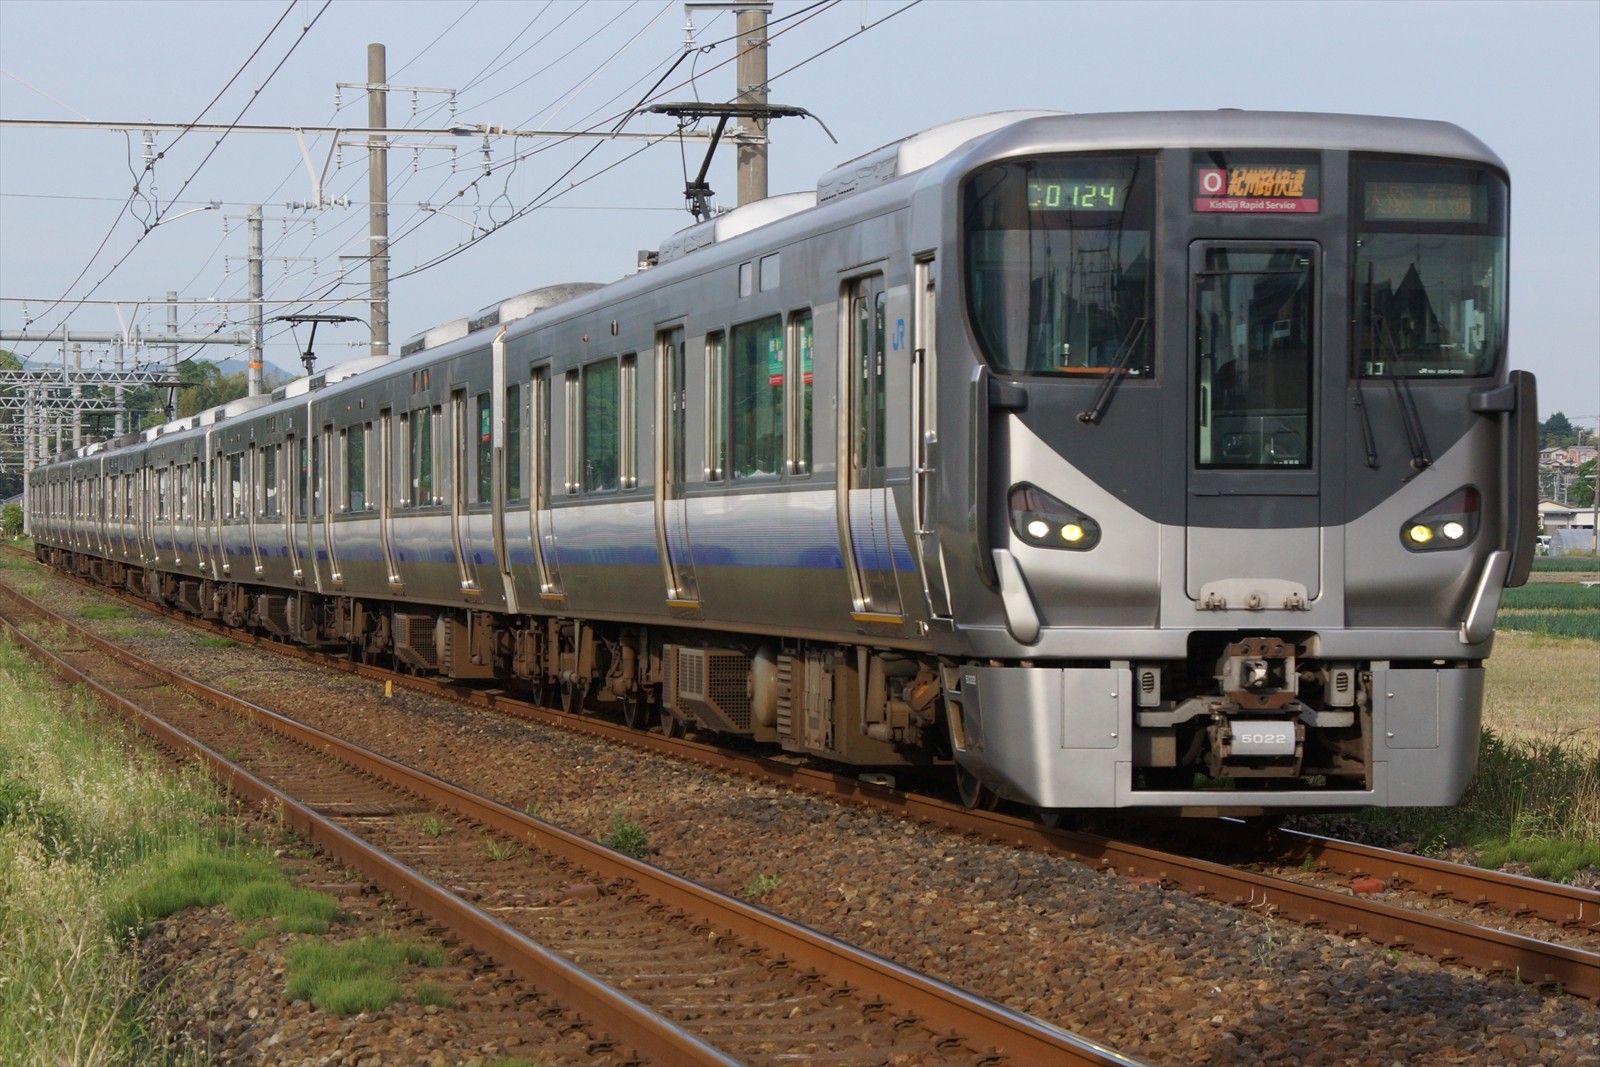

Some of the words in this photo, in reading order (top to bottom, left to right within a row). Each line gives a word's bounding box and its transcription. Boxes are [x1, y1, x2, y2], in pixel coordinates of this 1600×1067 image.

[1227, 168, 1306, 196] 紀州路快速
[1240, 201, 1264, 211] Rapid
[1266, 201, 1296, 210] Service
[893, 319, 905, 351] JR
[1241, 734, 1286, 743] 5022
